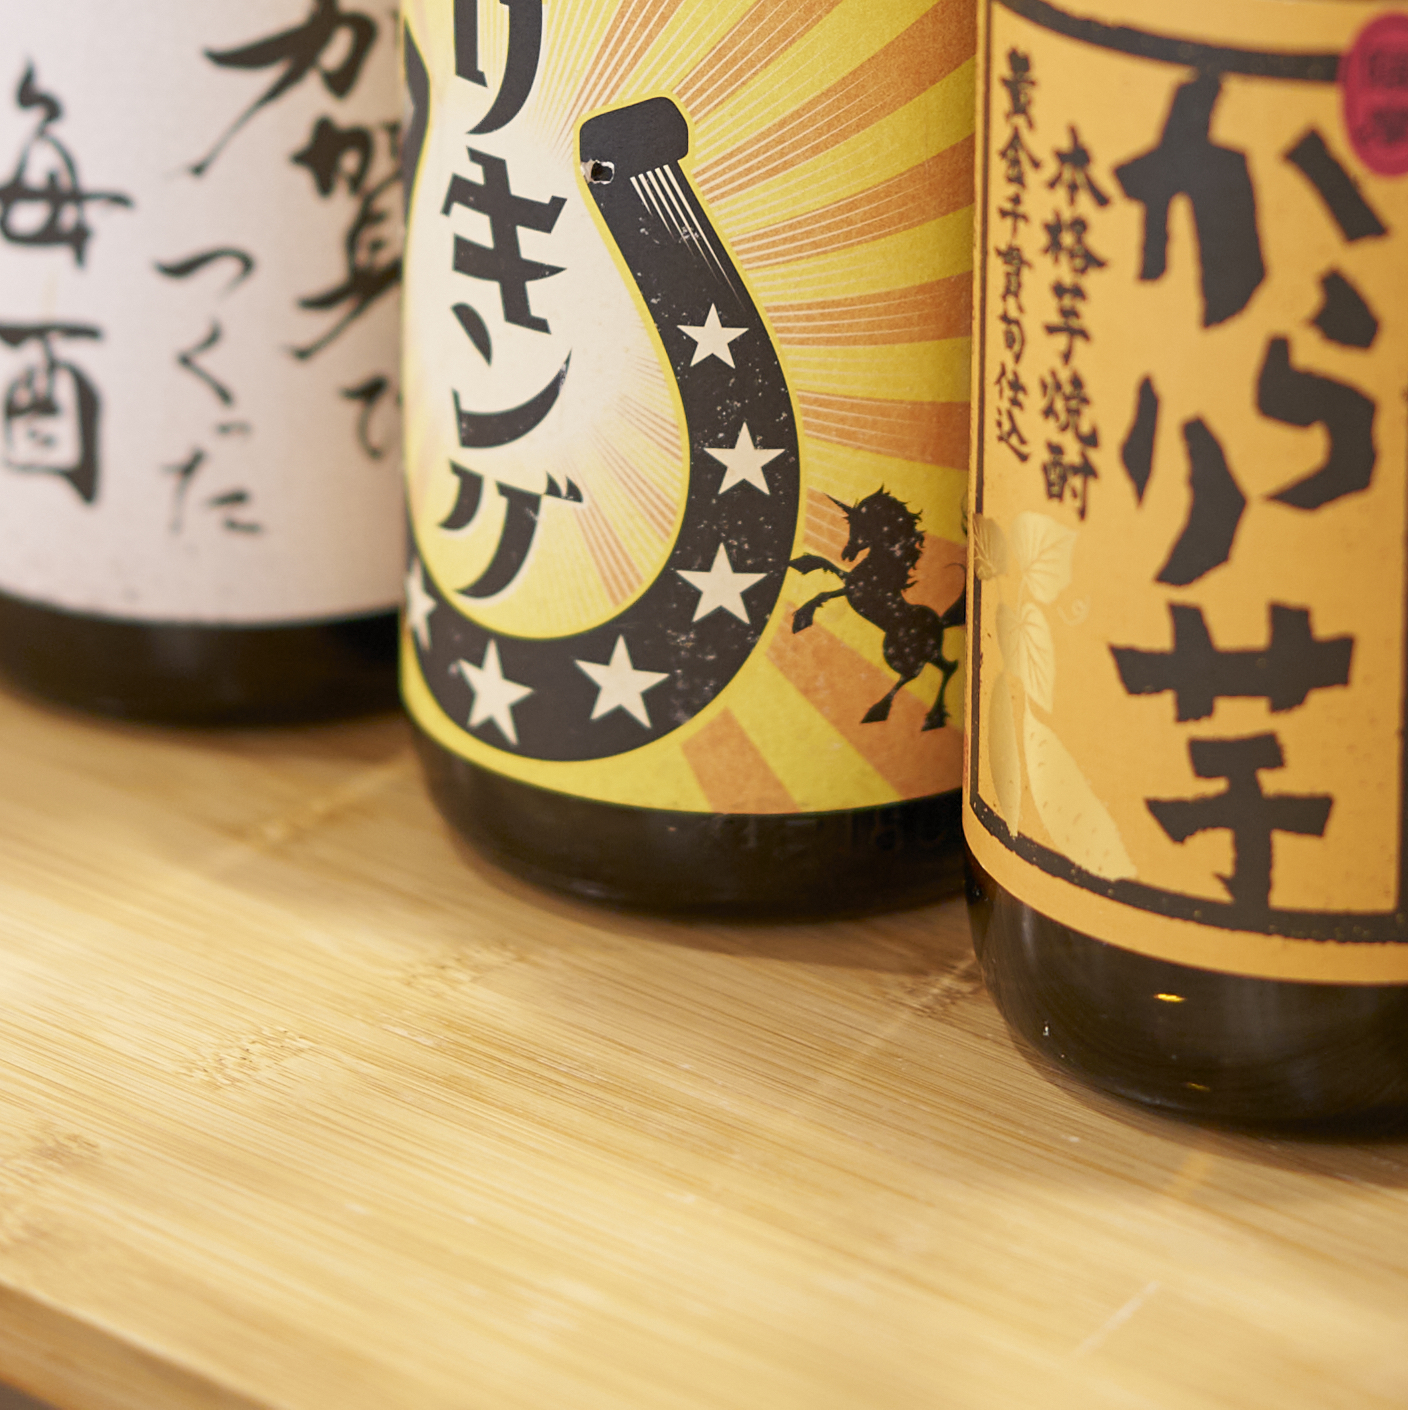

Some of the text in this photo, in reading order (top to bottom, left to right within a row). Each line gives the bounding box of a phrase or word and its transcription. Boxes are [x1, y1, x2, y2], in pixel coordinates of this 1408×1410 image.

[155, 246, 267, 536] つくった
[1039, 124, 1110, 522] 本格芋焼酎
[1109, 68, 1389, 909] からり芋
